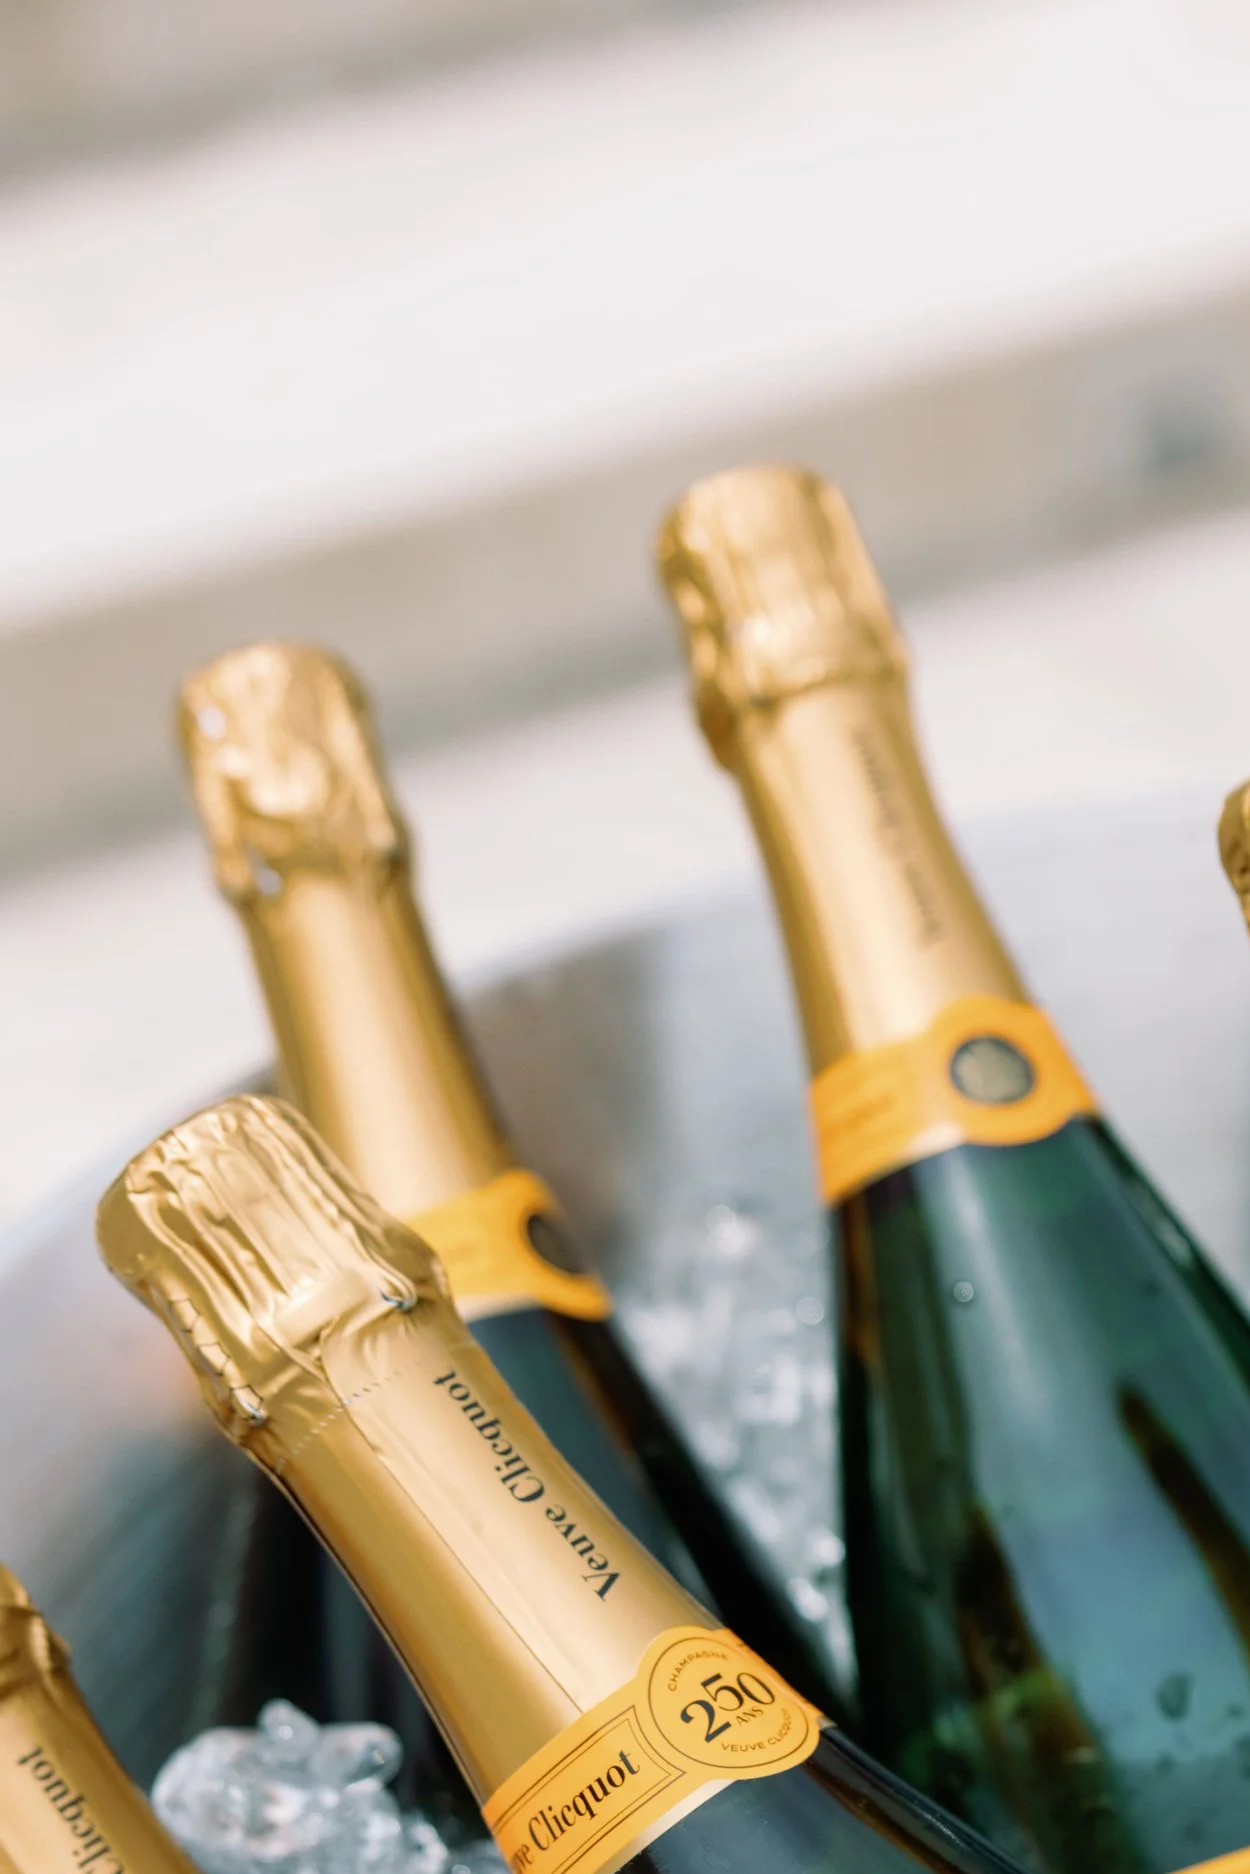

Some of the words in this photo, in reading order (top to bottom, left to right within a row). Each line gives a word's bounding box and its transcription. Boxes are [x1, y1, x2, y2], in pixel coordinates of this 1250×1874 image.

[433, 1367, 546, 1505] Clicquot
[545, 1503, 623, 1602] Veuve
[668, 1650, 728, 1692] CHAMPAGNE
[680, 1672, 776, 1744] 250
[735, 1706, 765, 1726] ANS
[721, 1742, 766, 1752] VEUVE
[528, 1749, 640, 1852] Clicquot
